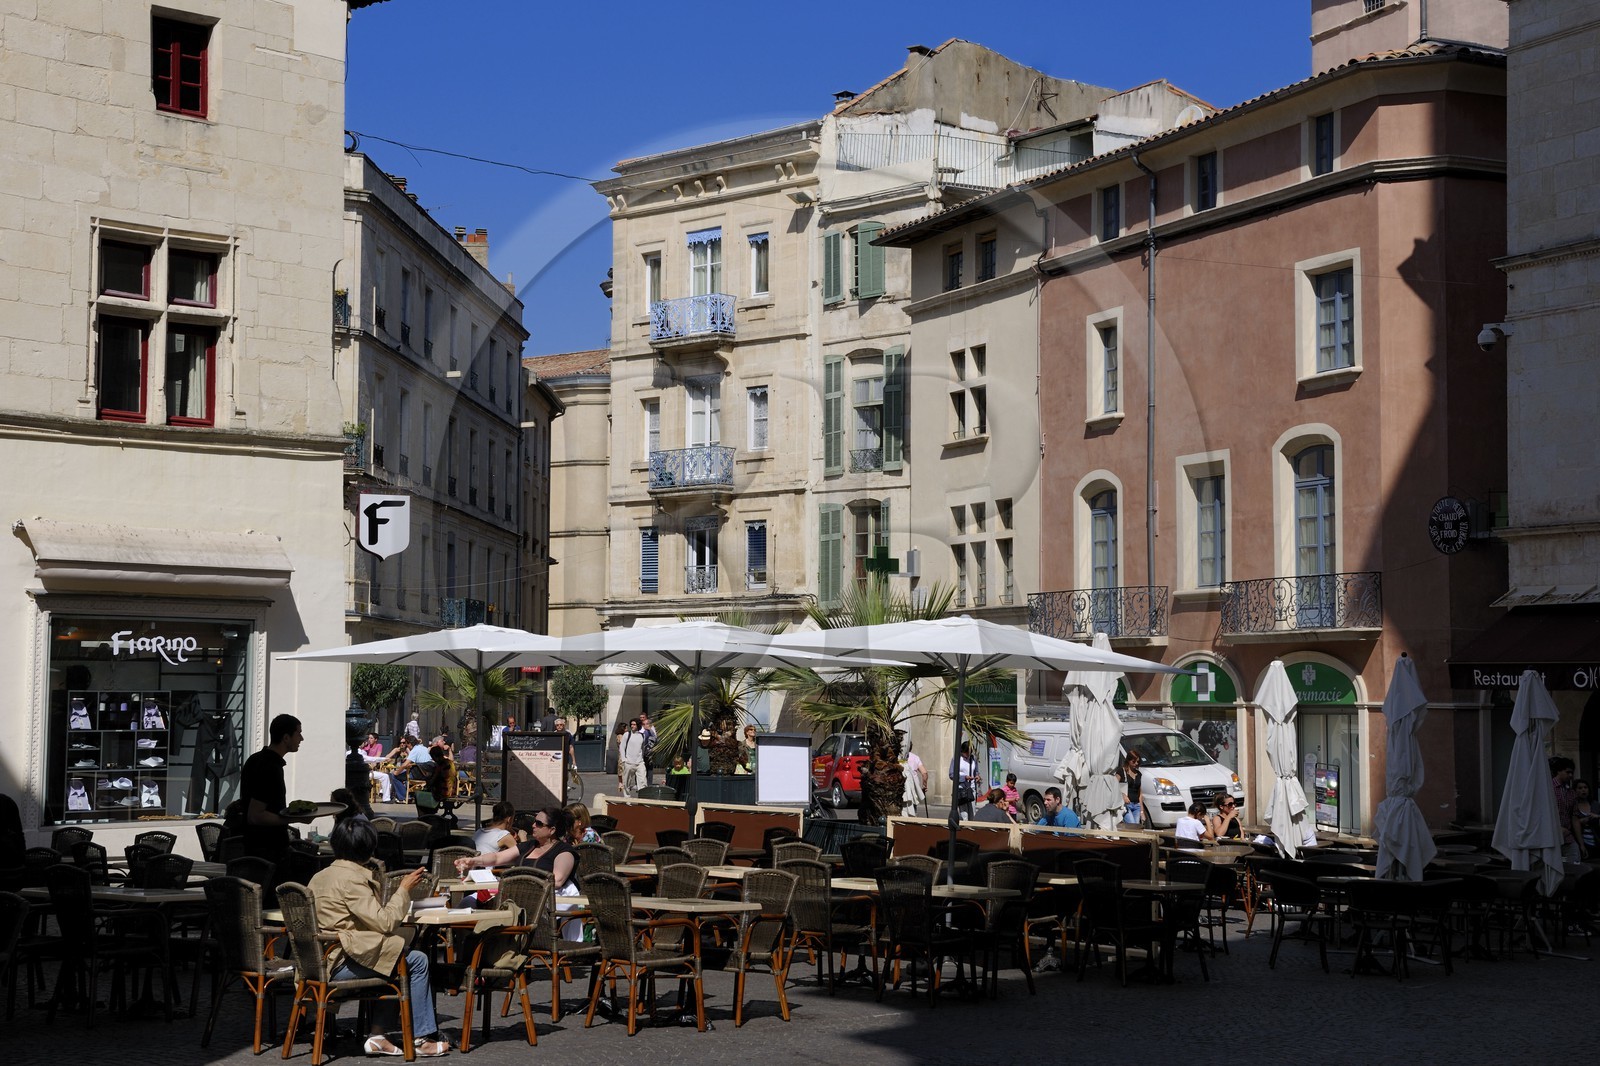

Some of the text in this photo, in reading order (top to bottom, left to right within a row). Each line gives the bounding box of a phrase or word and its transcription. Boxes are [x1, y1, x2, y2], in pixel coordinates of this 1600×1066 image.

[1438, 512, 1458, 521] CHAUD
[1444, 521, 1453, 530] OU
[1440, 529, 1458, 539] FROID
[1473, 669, 1546, 686] Restaurt
[1295, 686, 1342, 702] armacie
